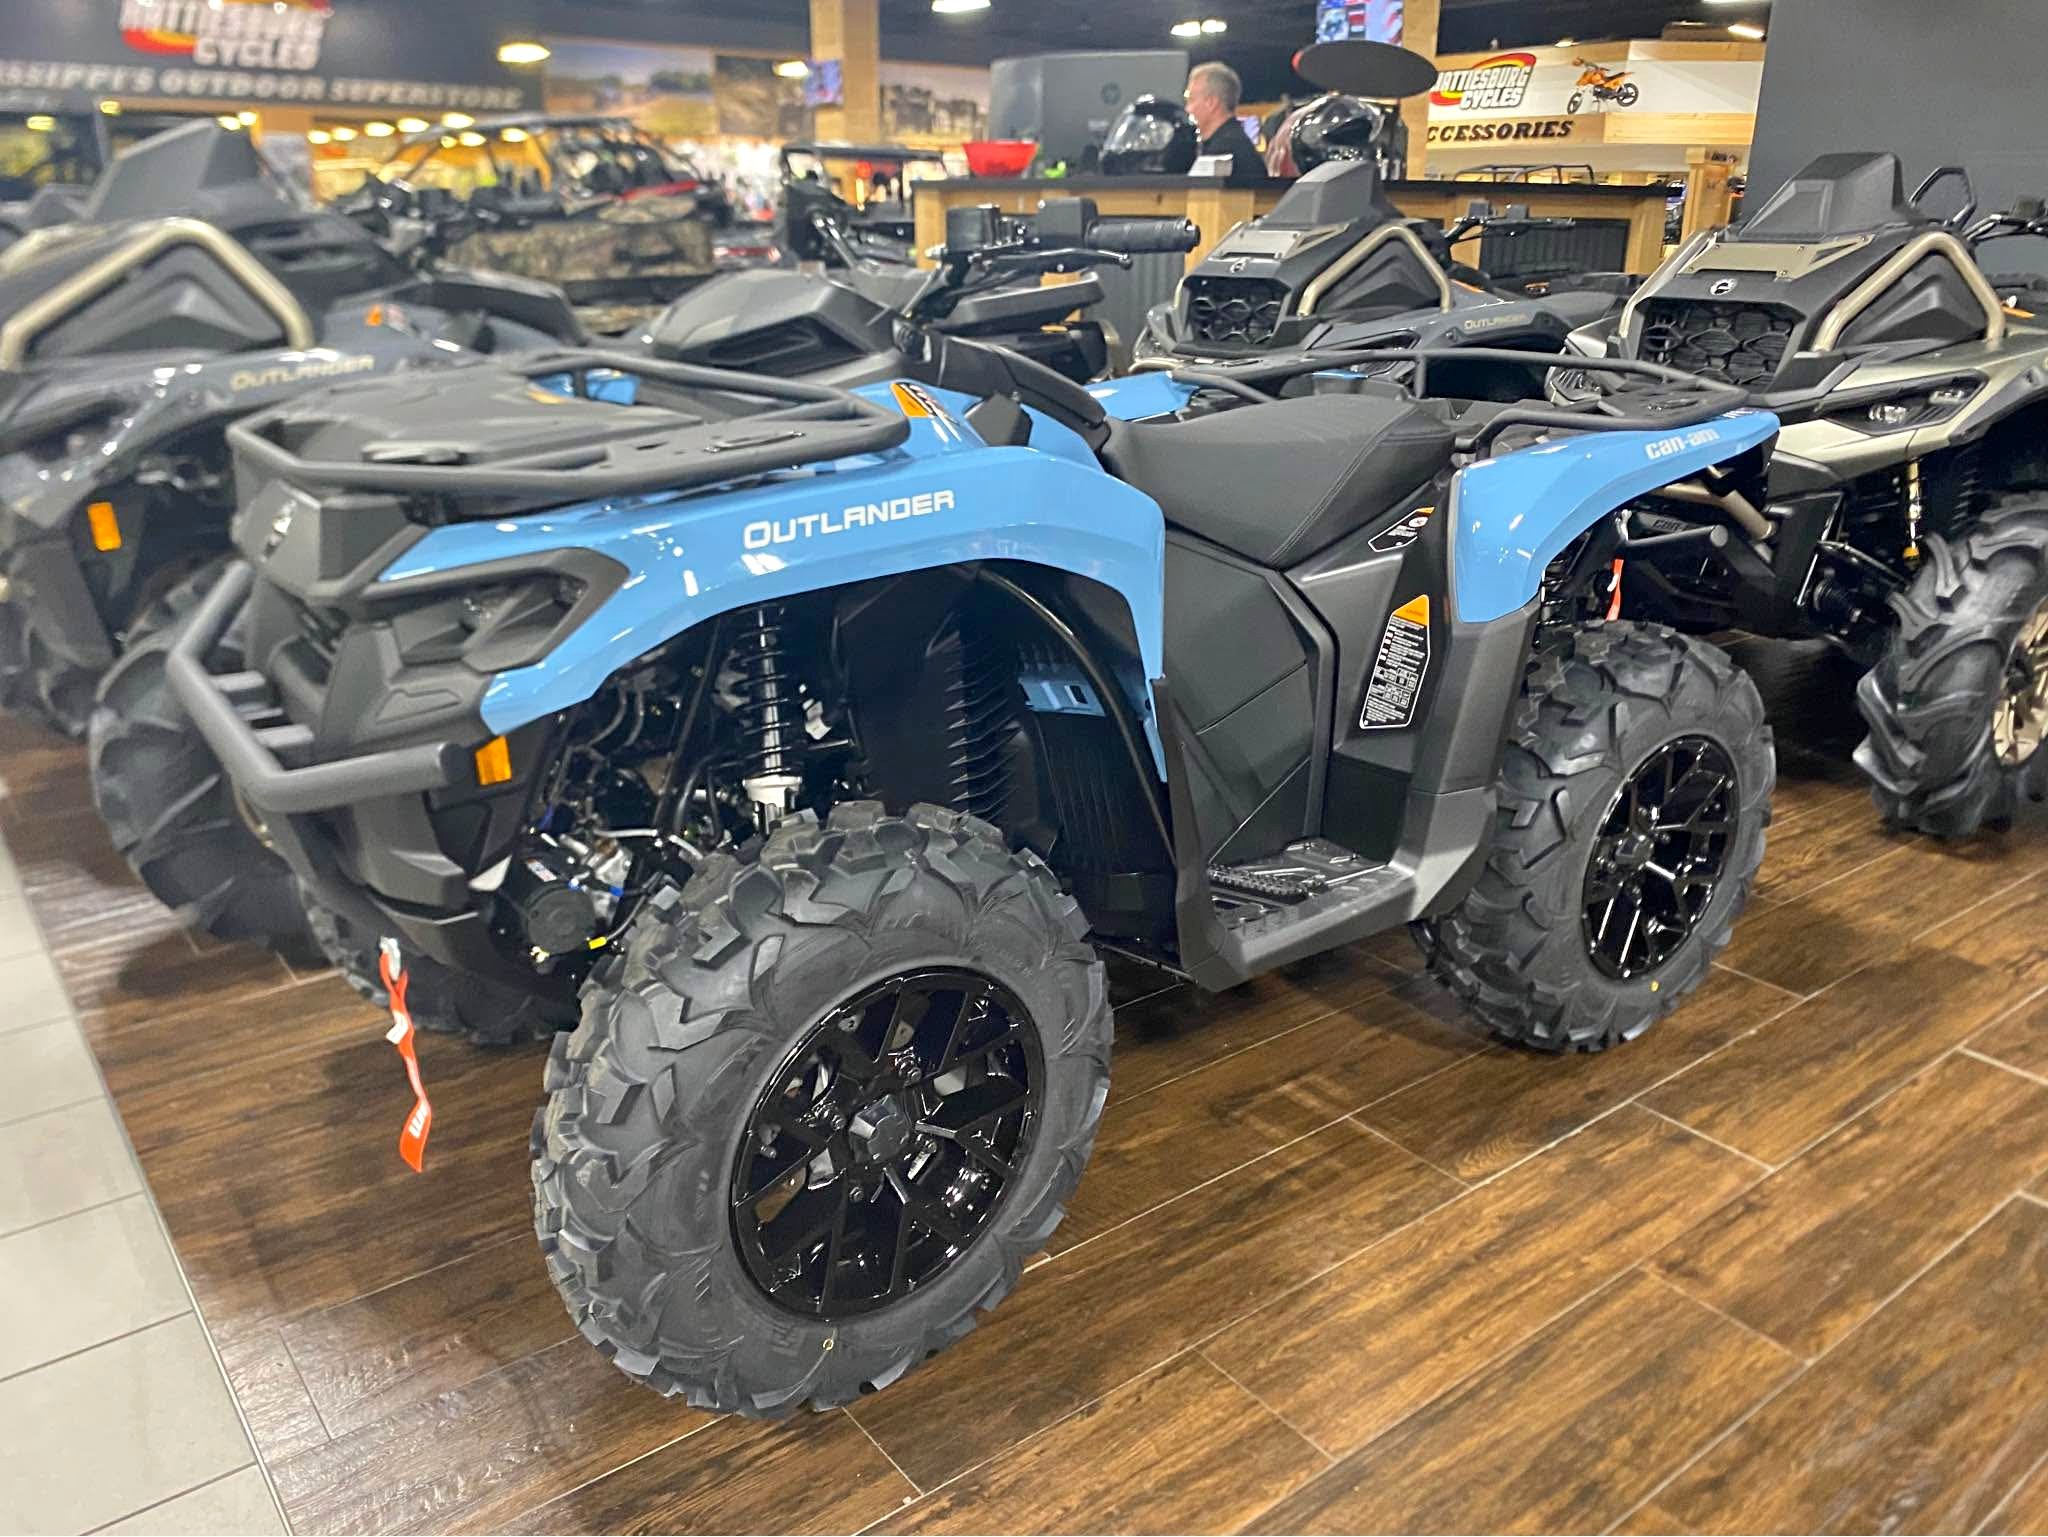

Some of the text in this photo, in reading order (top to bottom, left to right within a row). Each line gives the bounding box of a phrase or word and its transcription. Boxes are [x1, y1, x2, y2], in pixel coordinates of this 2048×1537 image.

[193, 37, 321, 71] CYCLES
[158, 66, 327, 101] OUTDOOR
[330, 77, 525, 109] SUPERSTORE
[1459, 86, 1524, 110] CYCLES
[229, 354, 375, 393] OUTLANDER
[1645, 427, 1721, 461] can-am
[743, 489, 956, 551] OUTLANDER
